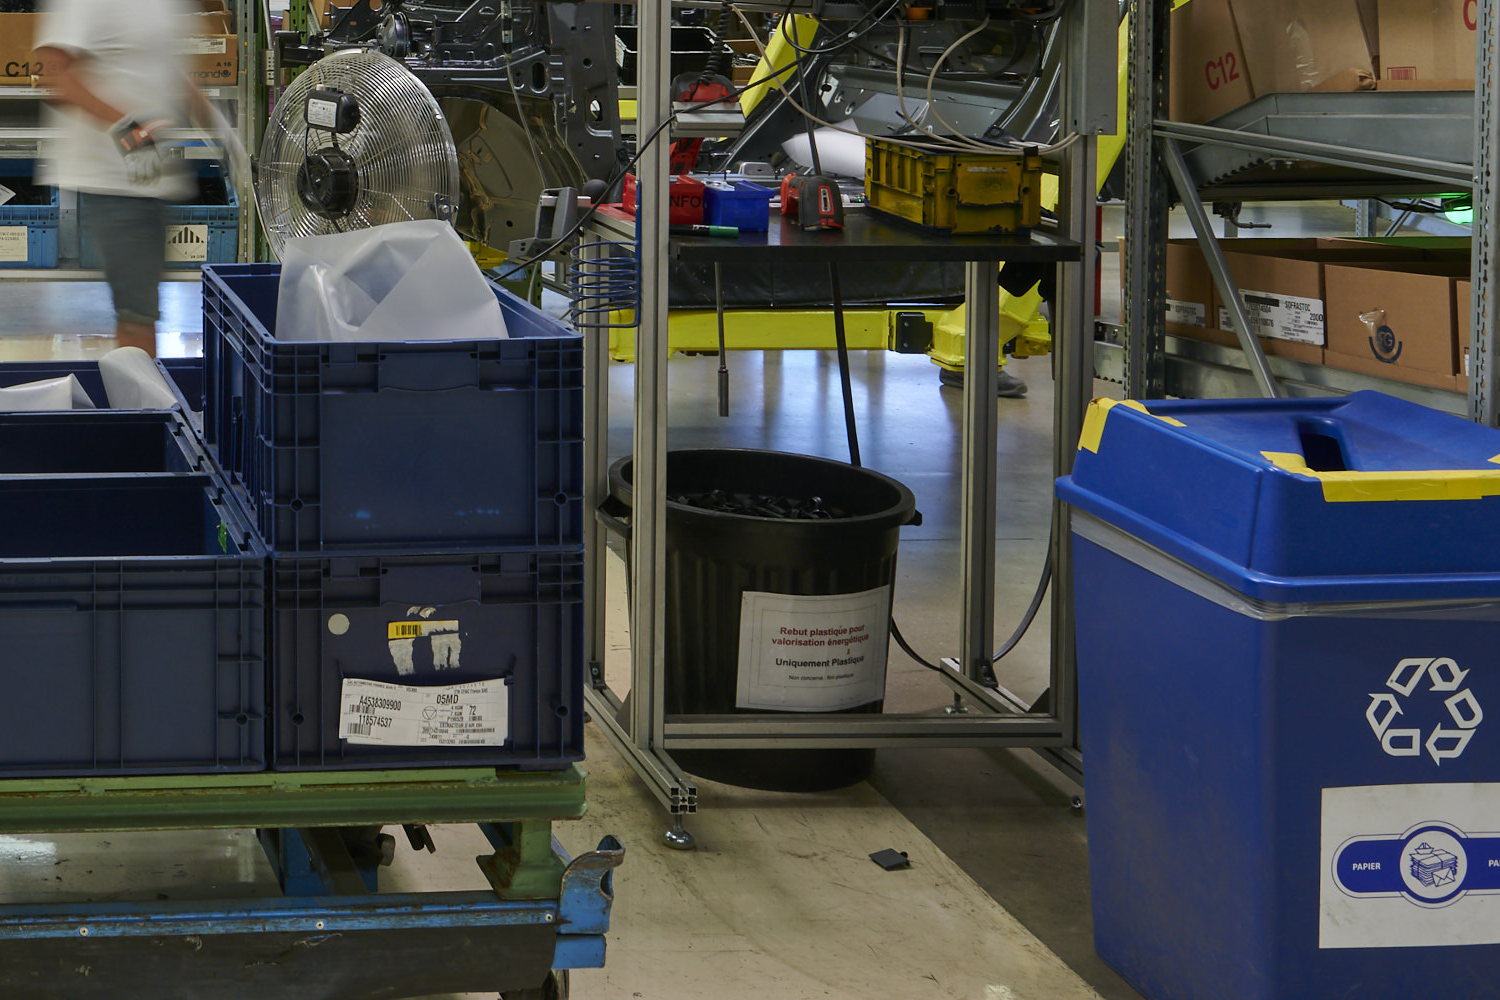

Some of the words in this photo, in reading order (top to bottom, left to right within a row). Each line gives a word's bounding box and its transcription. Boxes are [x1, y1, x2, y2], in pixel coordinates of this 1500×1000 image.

[5, 61, 44, 78] C12
[1205, 51, 1240, 91] C12
[780, 626, 808, 636] Rebut
[810, 627, 848, 638] plastique
[849, 624, 865, 635] pour
[772, 637, 825, 647] valorisation
[827, 634, 869, 646] énergétique
[775, 658, 830, 668] Uniquement
[832, 655, 865, 667] Plastique
[359, 695, 402, 711] A4538309900
[436, 694, 459, 704] 05MD
[468, 705, 477, 716] 72
[358, 714, 393, 728] 118574537
[1352, 862, 1381, 871] PAPIER
[1488, 859, 1500, 868] PA
